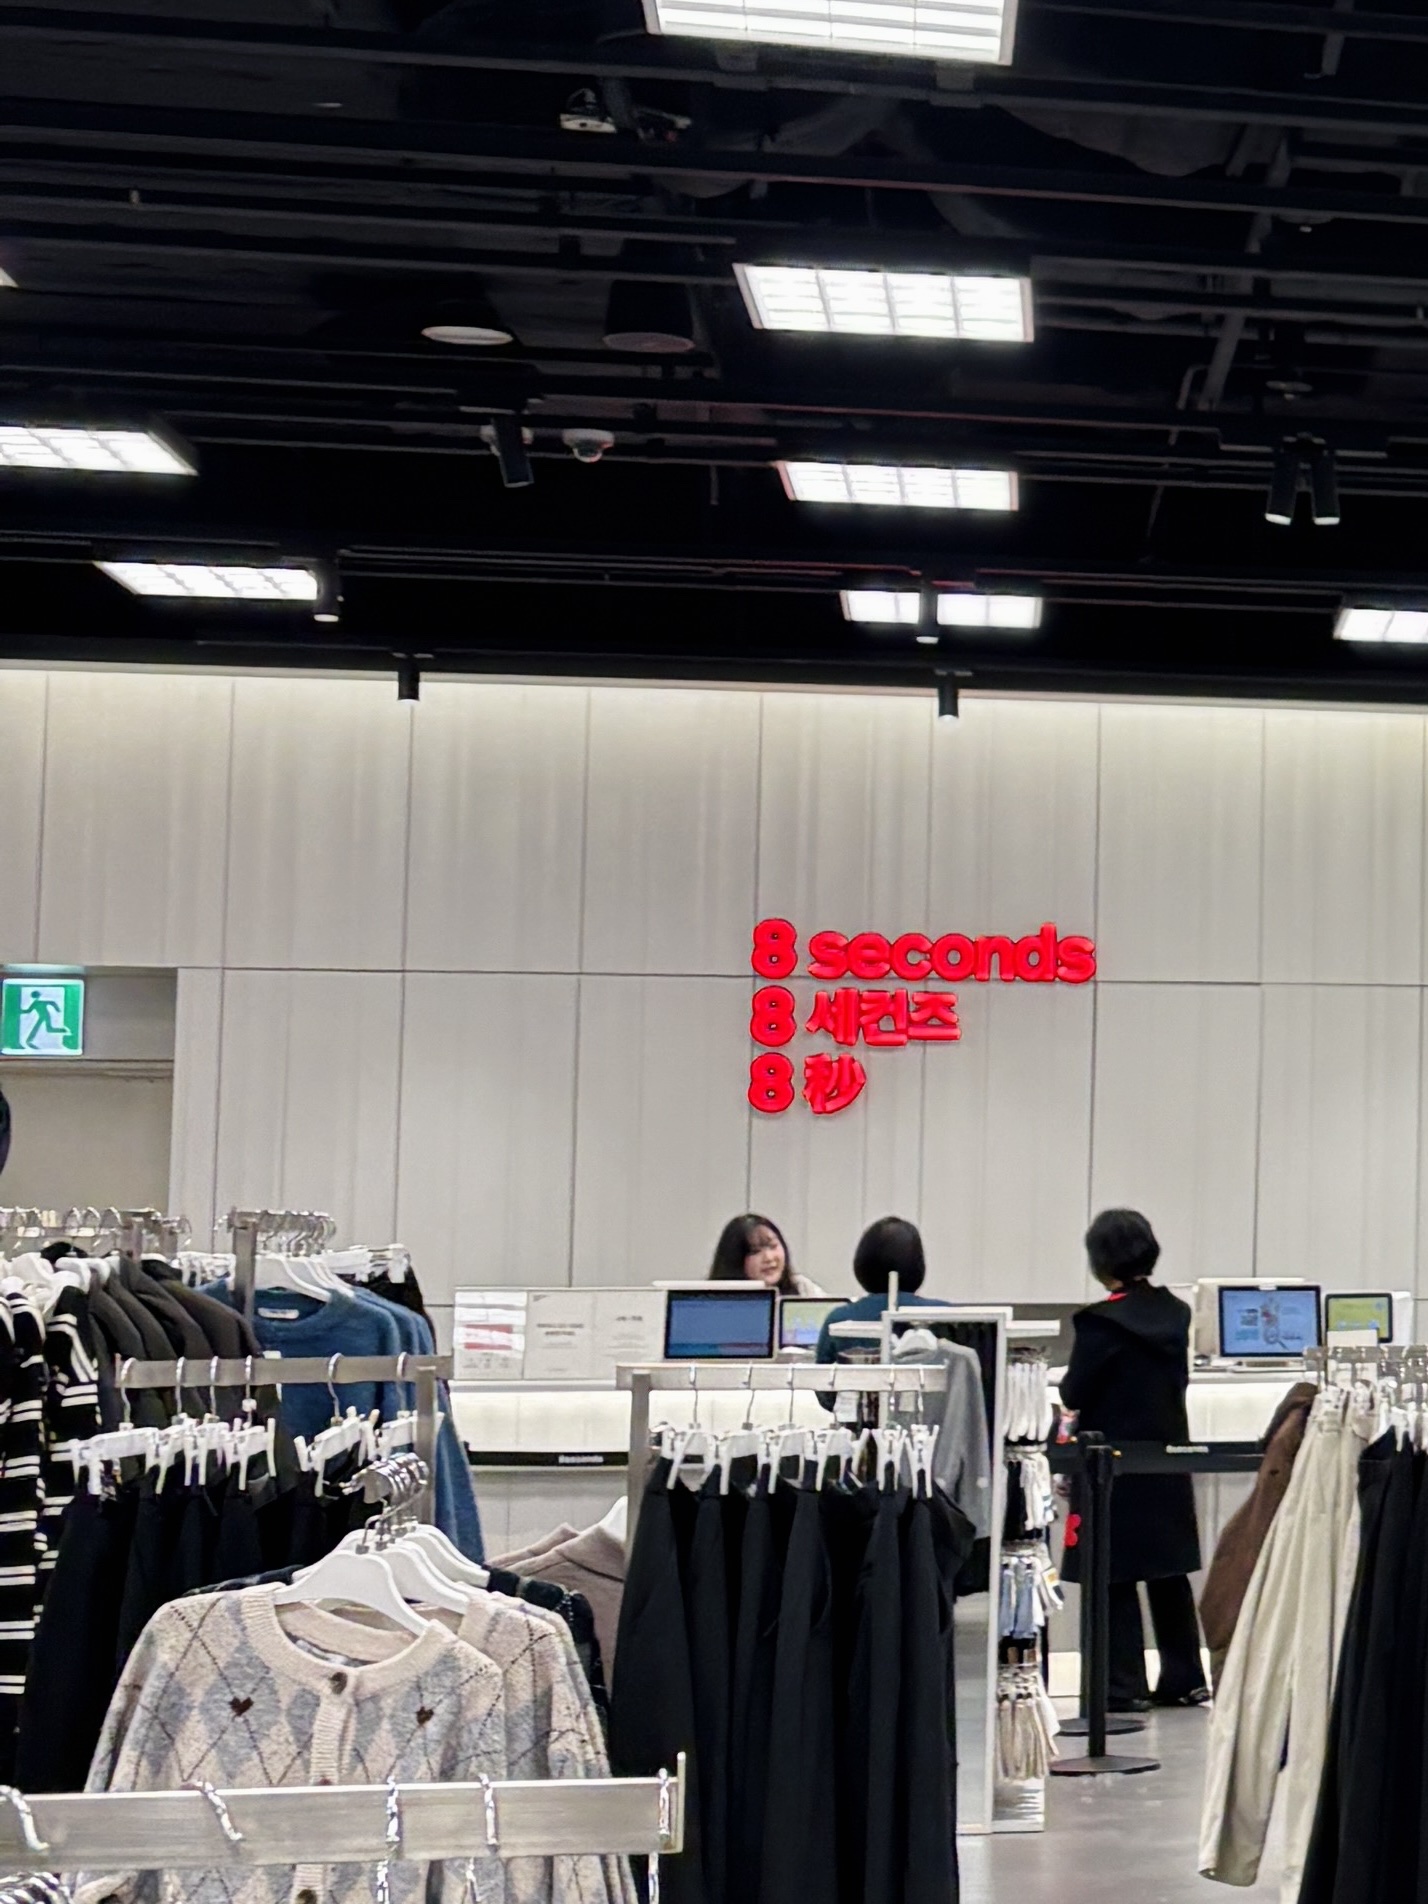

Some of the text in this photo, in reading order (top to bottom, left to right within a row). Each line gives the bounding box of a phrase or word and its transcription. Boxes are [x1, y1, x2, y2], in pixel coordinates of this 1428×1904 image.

[751, 918, 1098, 984] 8 seconds
[749, 985, 962, 1047] 8 세컨즈
[747, 1052, 867, 1115] 8 秒
